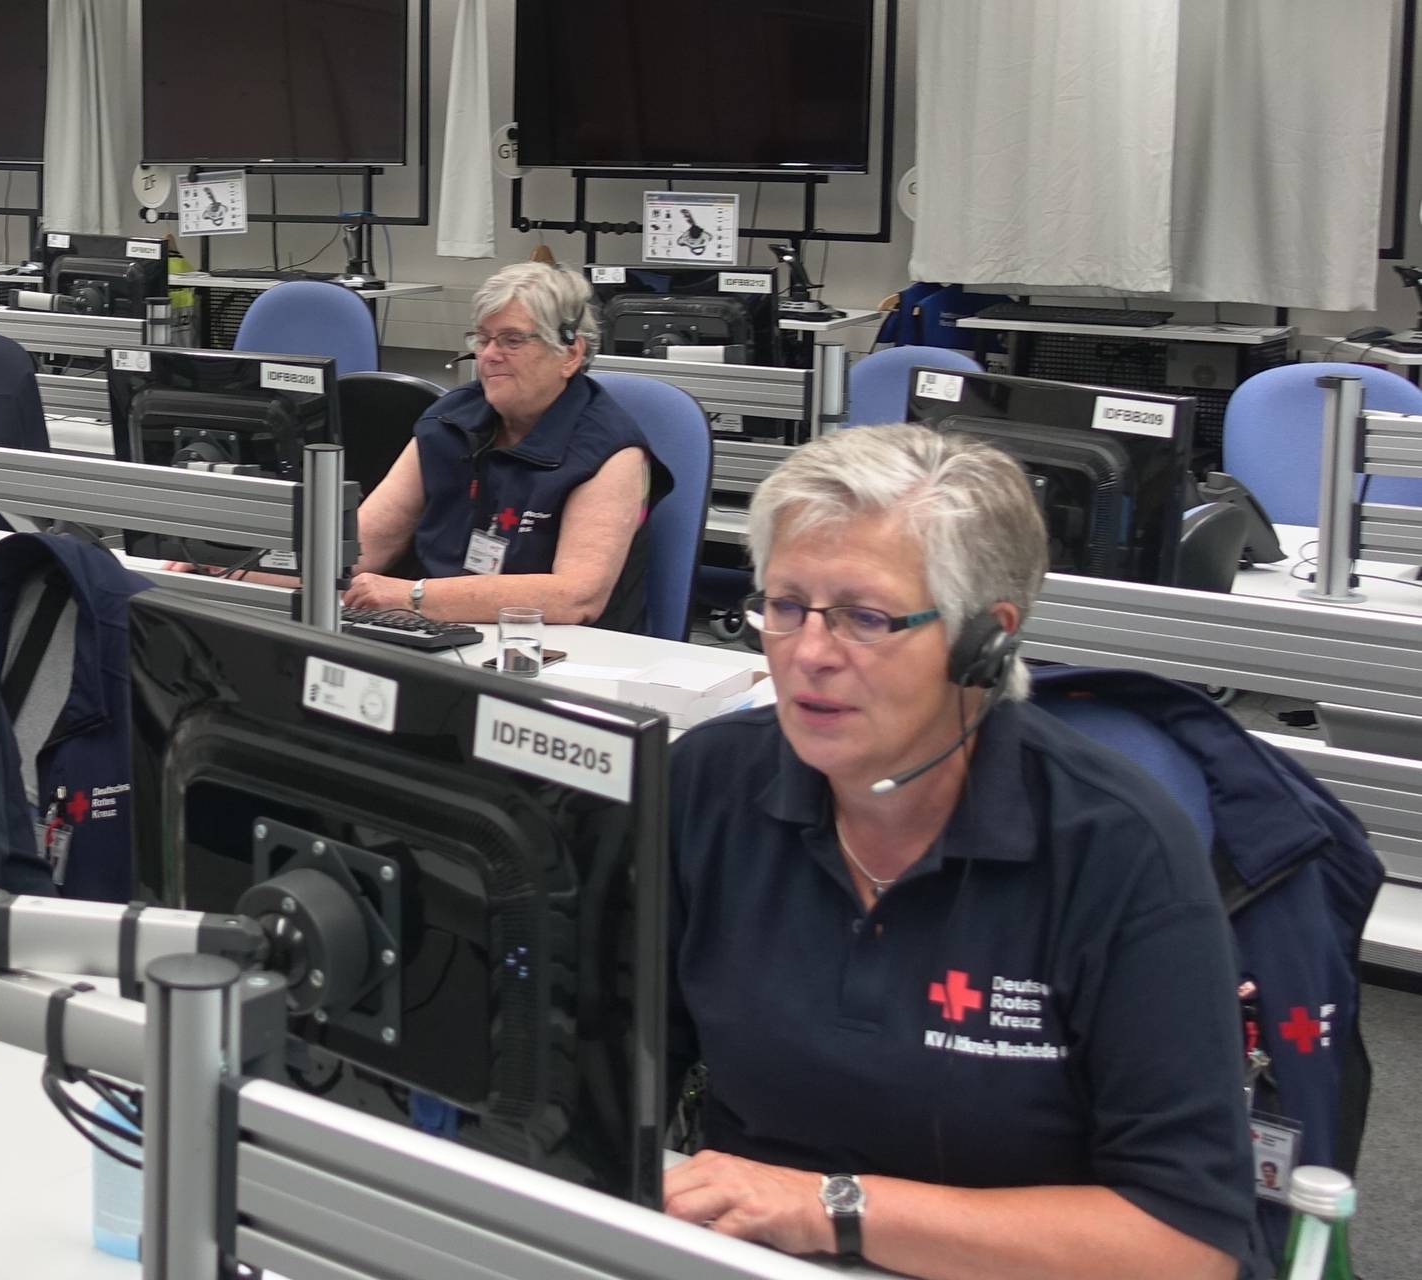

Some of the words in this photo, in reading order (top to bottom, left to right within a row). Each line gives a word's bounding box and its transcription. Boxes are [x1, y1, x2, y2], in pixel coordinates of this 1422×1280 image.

[267, 370, 316, 385] IDFBB208
[1102, 407, 1165, 427] IDFBB209
[491, 719, 613, 775] IDFBB205
[990, 993, 1042, 1011] Rotes
[989, 1011, 1043, 1029] Kreuz
[924, 1030, 947, 1048] KV
